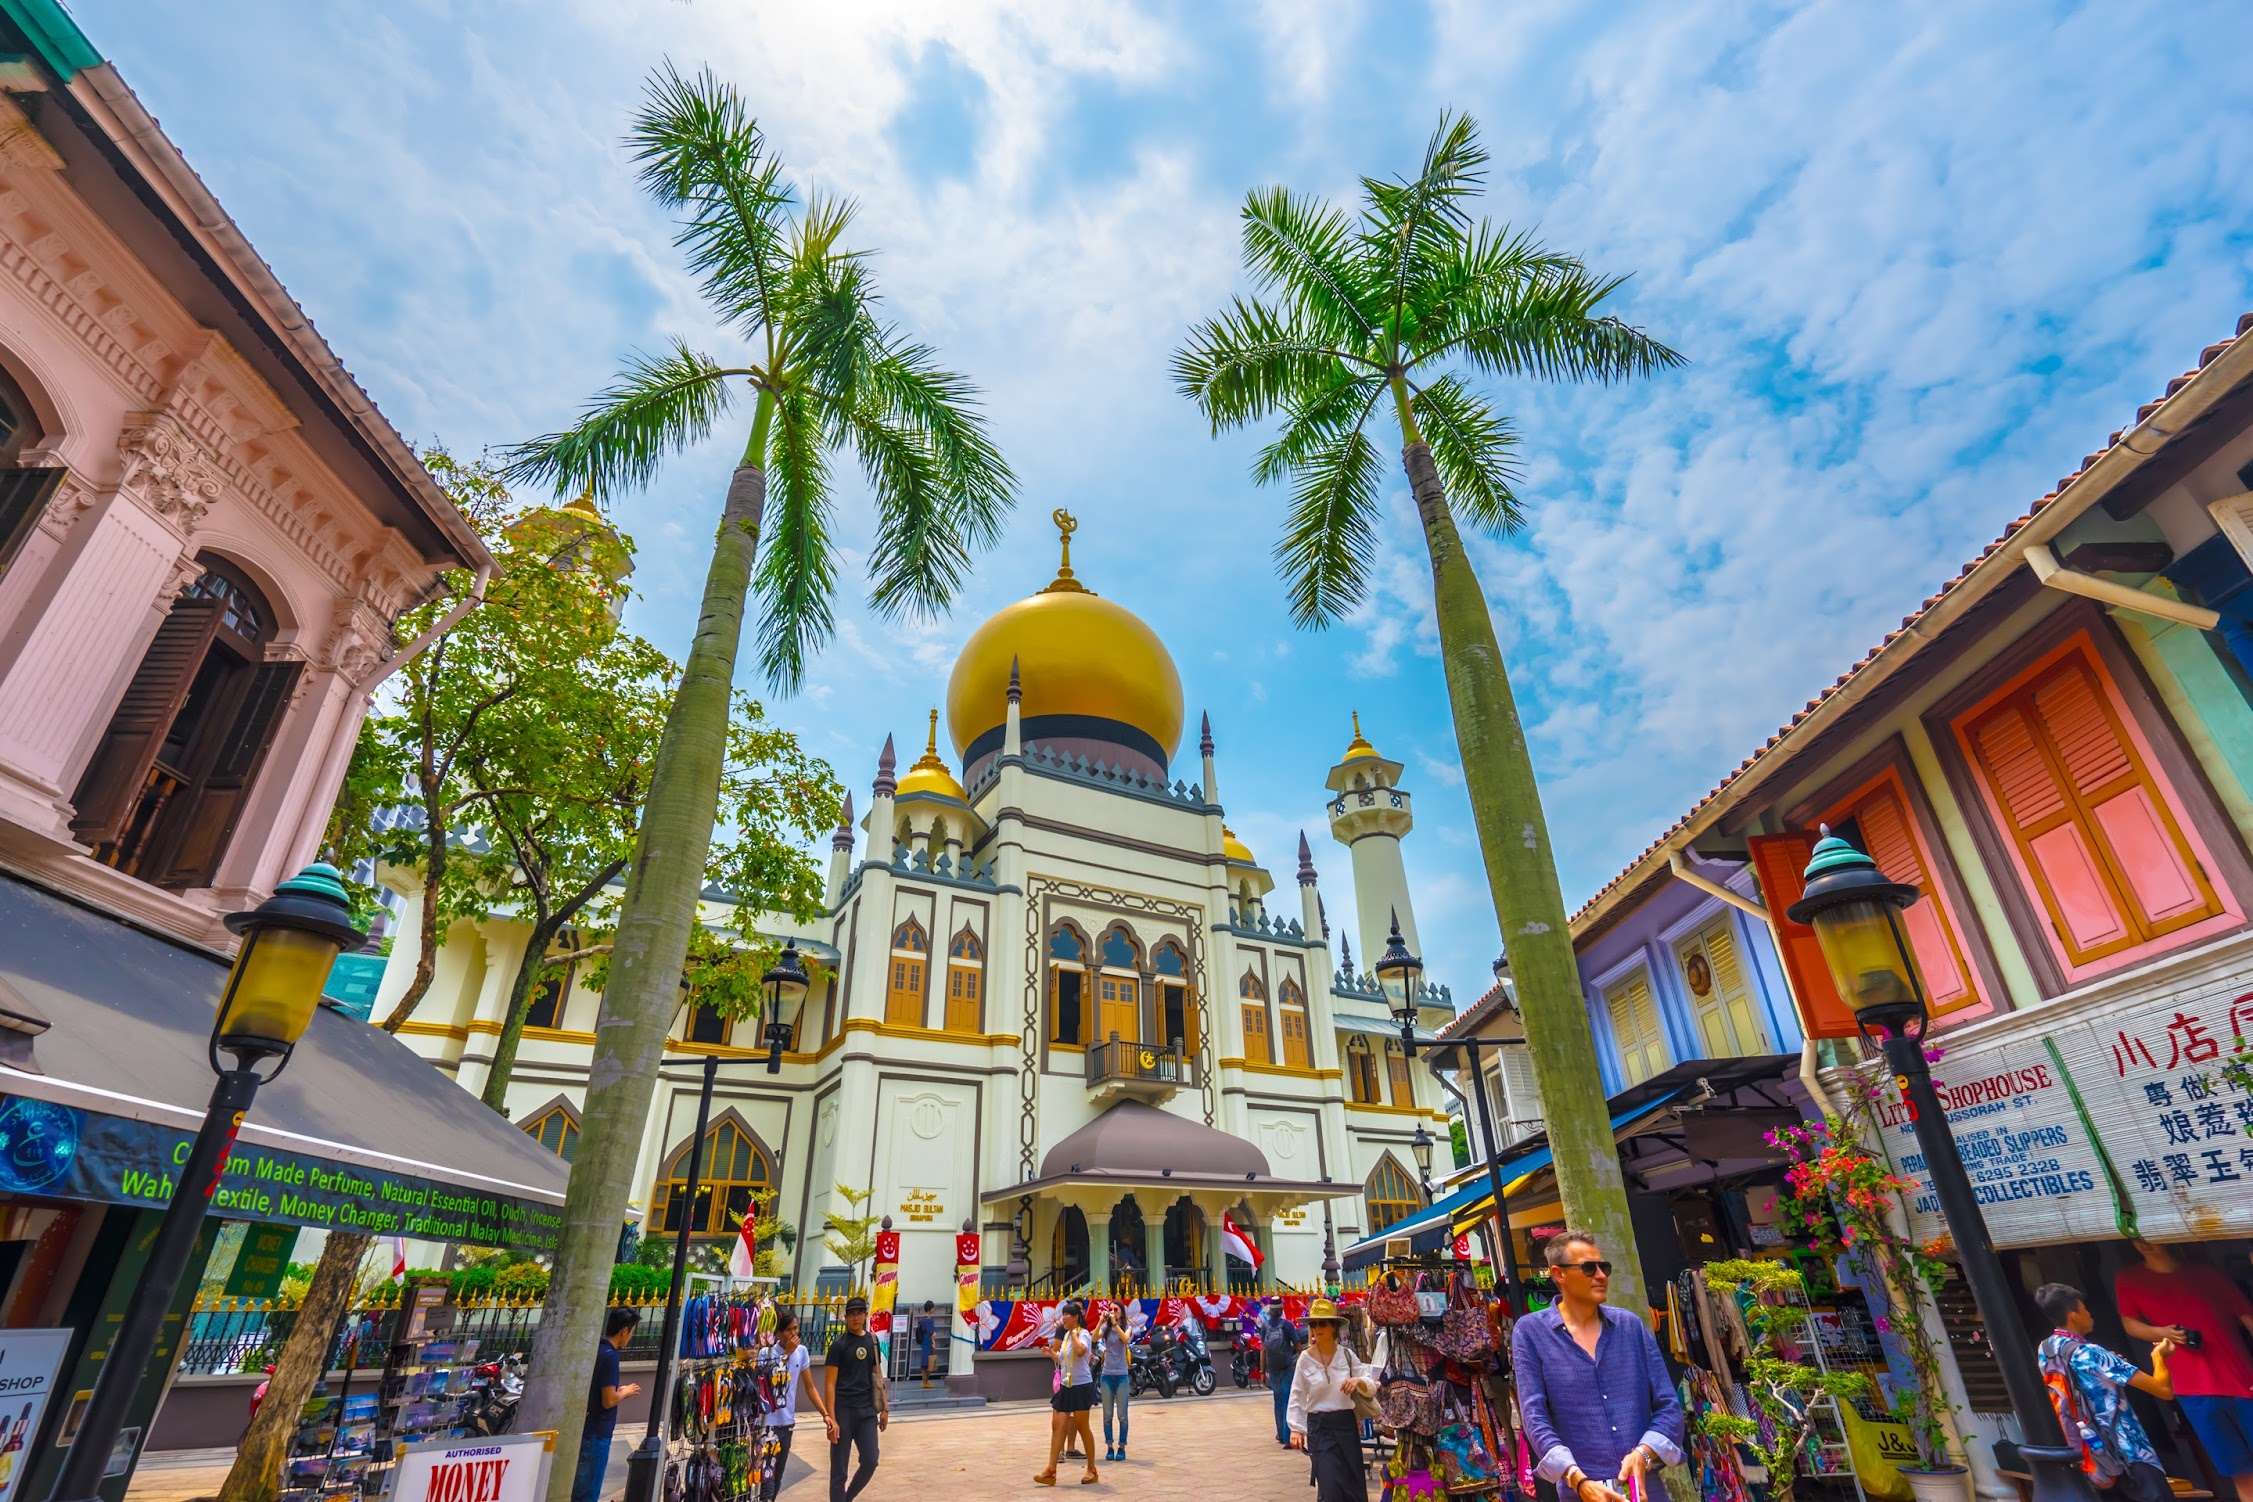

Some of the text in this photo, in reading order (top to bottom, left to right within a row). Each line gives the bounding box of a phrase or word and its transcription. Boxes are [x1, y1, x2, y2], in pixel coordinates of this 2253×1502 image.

[1937, 1064, 2052, 1111] SHOPHOUSE
[1901, 1089, 1919, 1121] 5
[1946, 1101, 2006, 1123] USSORAH
[2013, 1095, 2038, 1108] ST.
[1957, 1138, 2002, 1162] BEADED
[2004, 1126, 2068, 1153] SLIPPERS
[1995, 1126, 2009, 1137] IN
[2017, 1159, 2060, 1176] 2328
[255, 1157, 305, 1186] Made
[309, 1167, 375, 1200] Perfume,
[381, 1180, 429, 1206] Natural
[431, 1190, 478, 1214] Essential
[481, 1200, 498, 1220] Oil,
[501, 1204, 528, 1223] Oudh,
[1973, 1170, 2094, 1204] COLLECTIBLES
[279, 1193, 336, 1225] Money
[339, 1203, 399, 1233] Changer,
[404, 1212, 467, 1238] Traditional
[470, 1222, 500, 1246] Malay
[502, 1227, 544, 1250] Medicine,
[900, 1203, 944, 1214] MASJID SULTAN
[445, 1446, 502, 1458] AUTHORISED
[425, 1459, 511, 1502] MONEY
